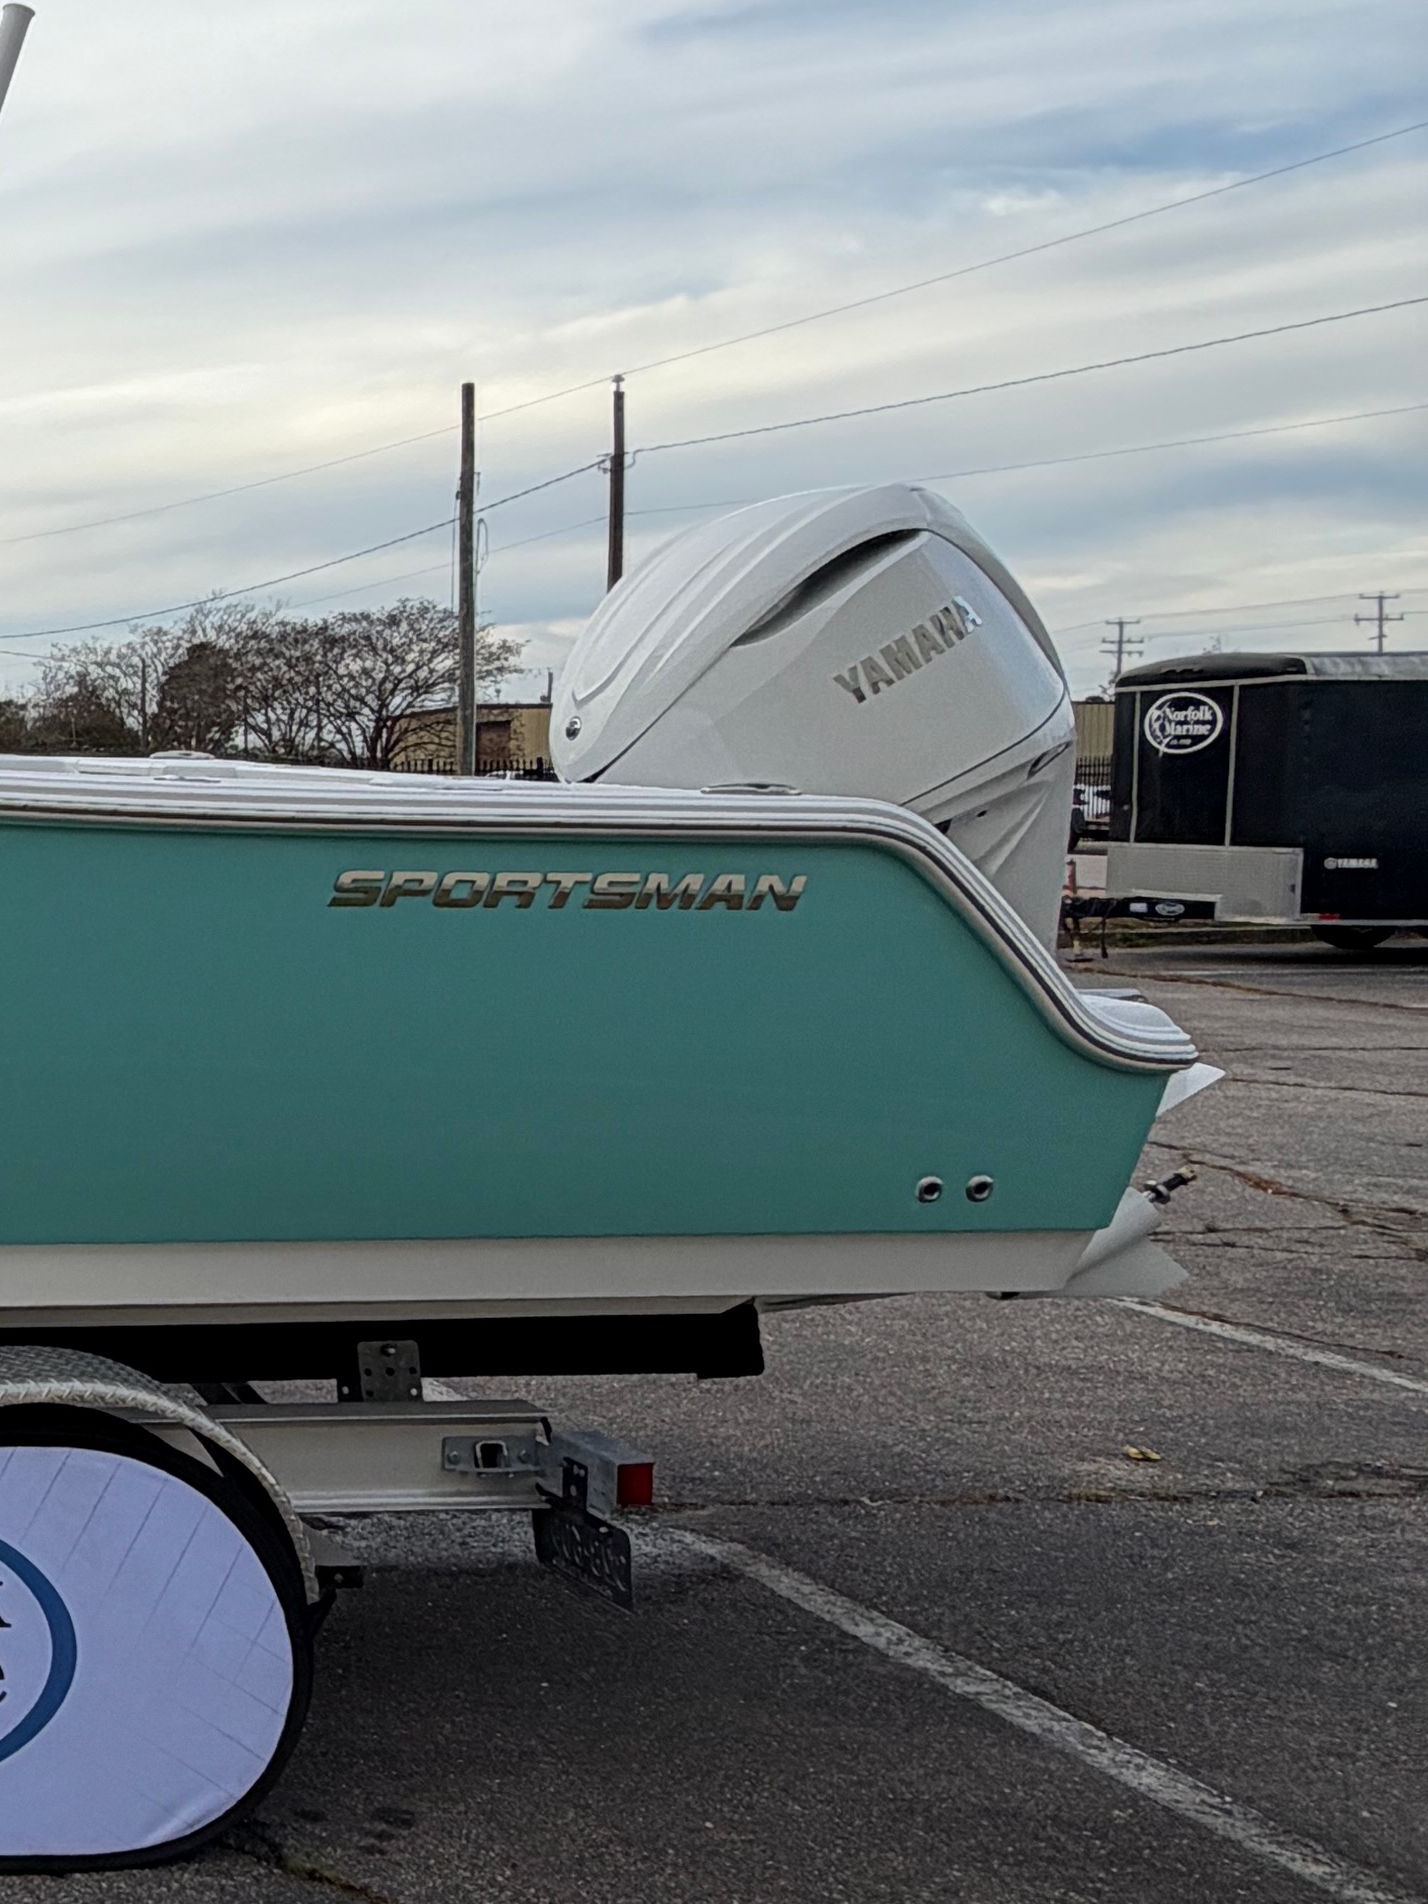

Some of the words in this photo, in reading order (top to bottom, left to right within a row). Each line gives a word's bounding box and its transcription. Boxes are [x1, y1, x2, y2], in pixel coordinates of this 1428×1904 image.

[832, 596, 983, 704] YAMAHA
[1165, 705, 1213, 721] Norfolk
[327, 870, 808, 912] SPORTSMAN
